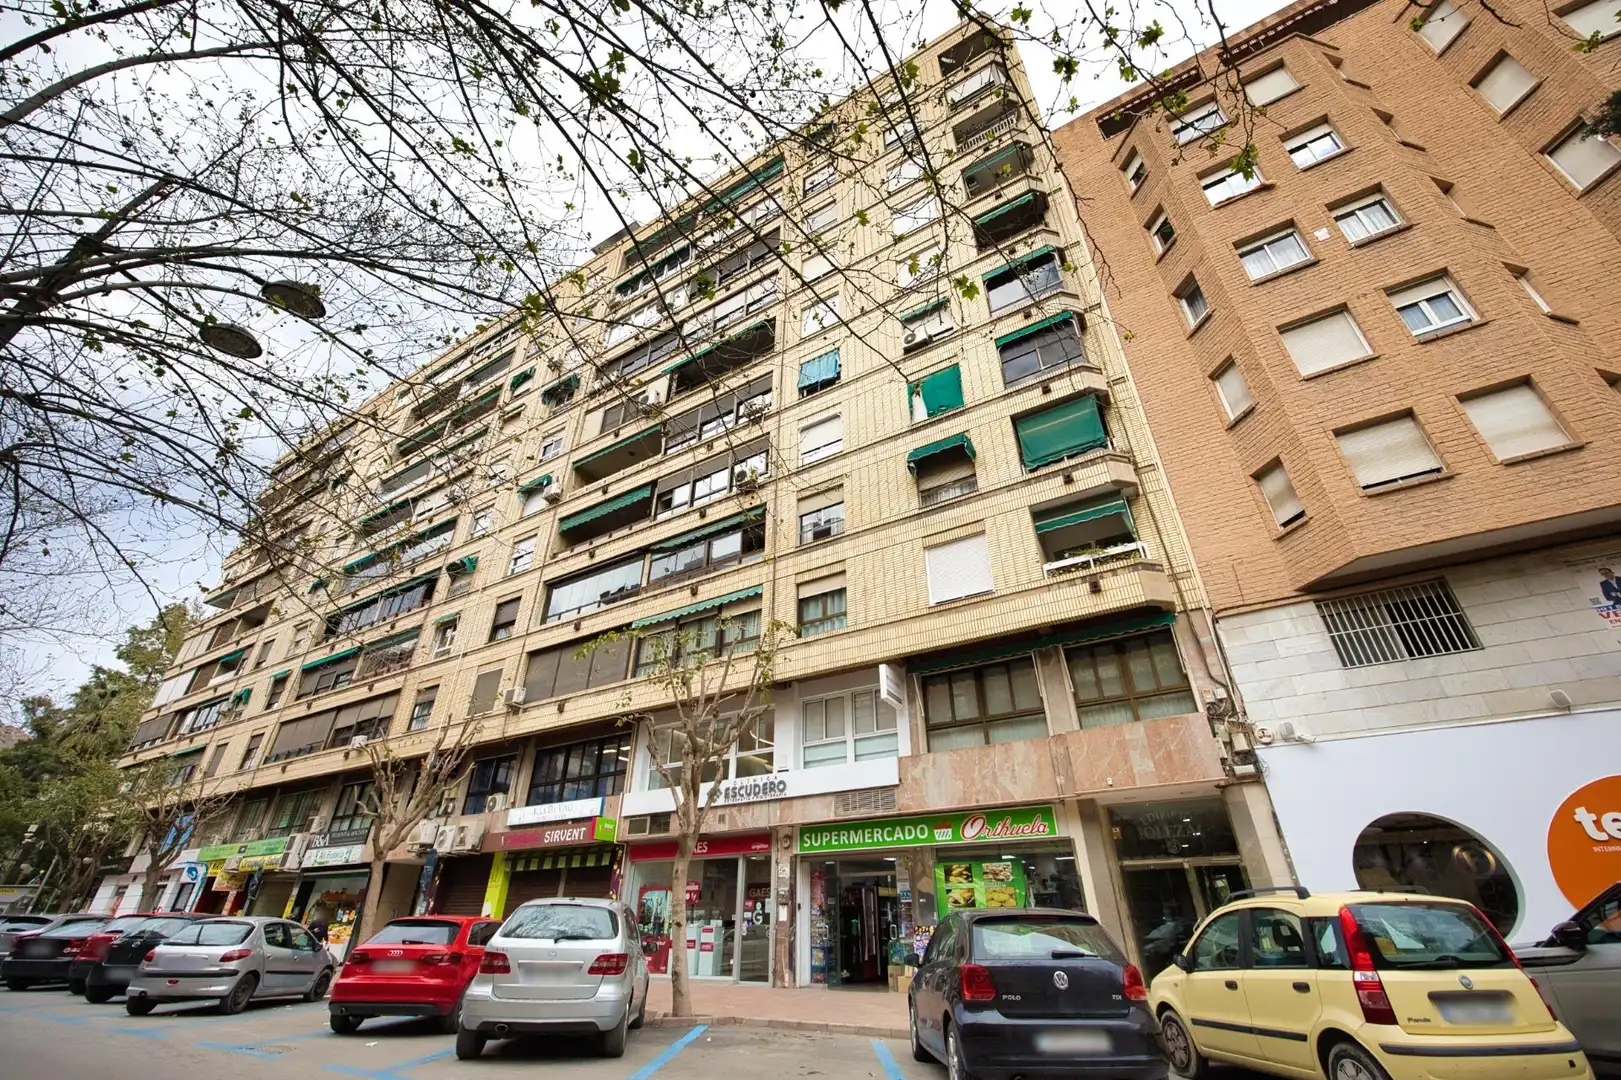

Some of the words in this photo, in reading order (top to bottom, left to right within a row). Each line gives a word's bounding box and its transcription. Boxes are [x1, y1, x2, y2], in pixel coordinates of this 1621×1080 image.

[724, 780, 787, 800] ESCUDERO
[544, 827, 587, 843] SIRVENT
[803, 824, 929, 848] SUPERMERCADO
[960, 813, 1049, 841] Orihuela
